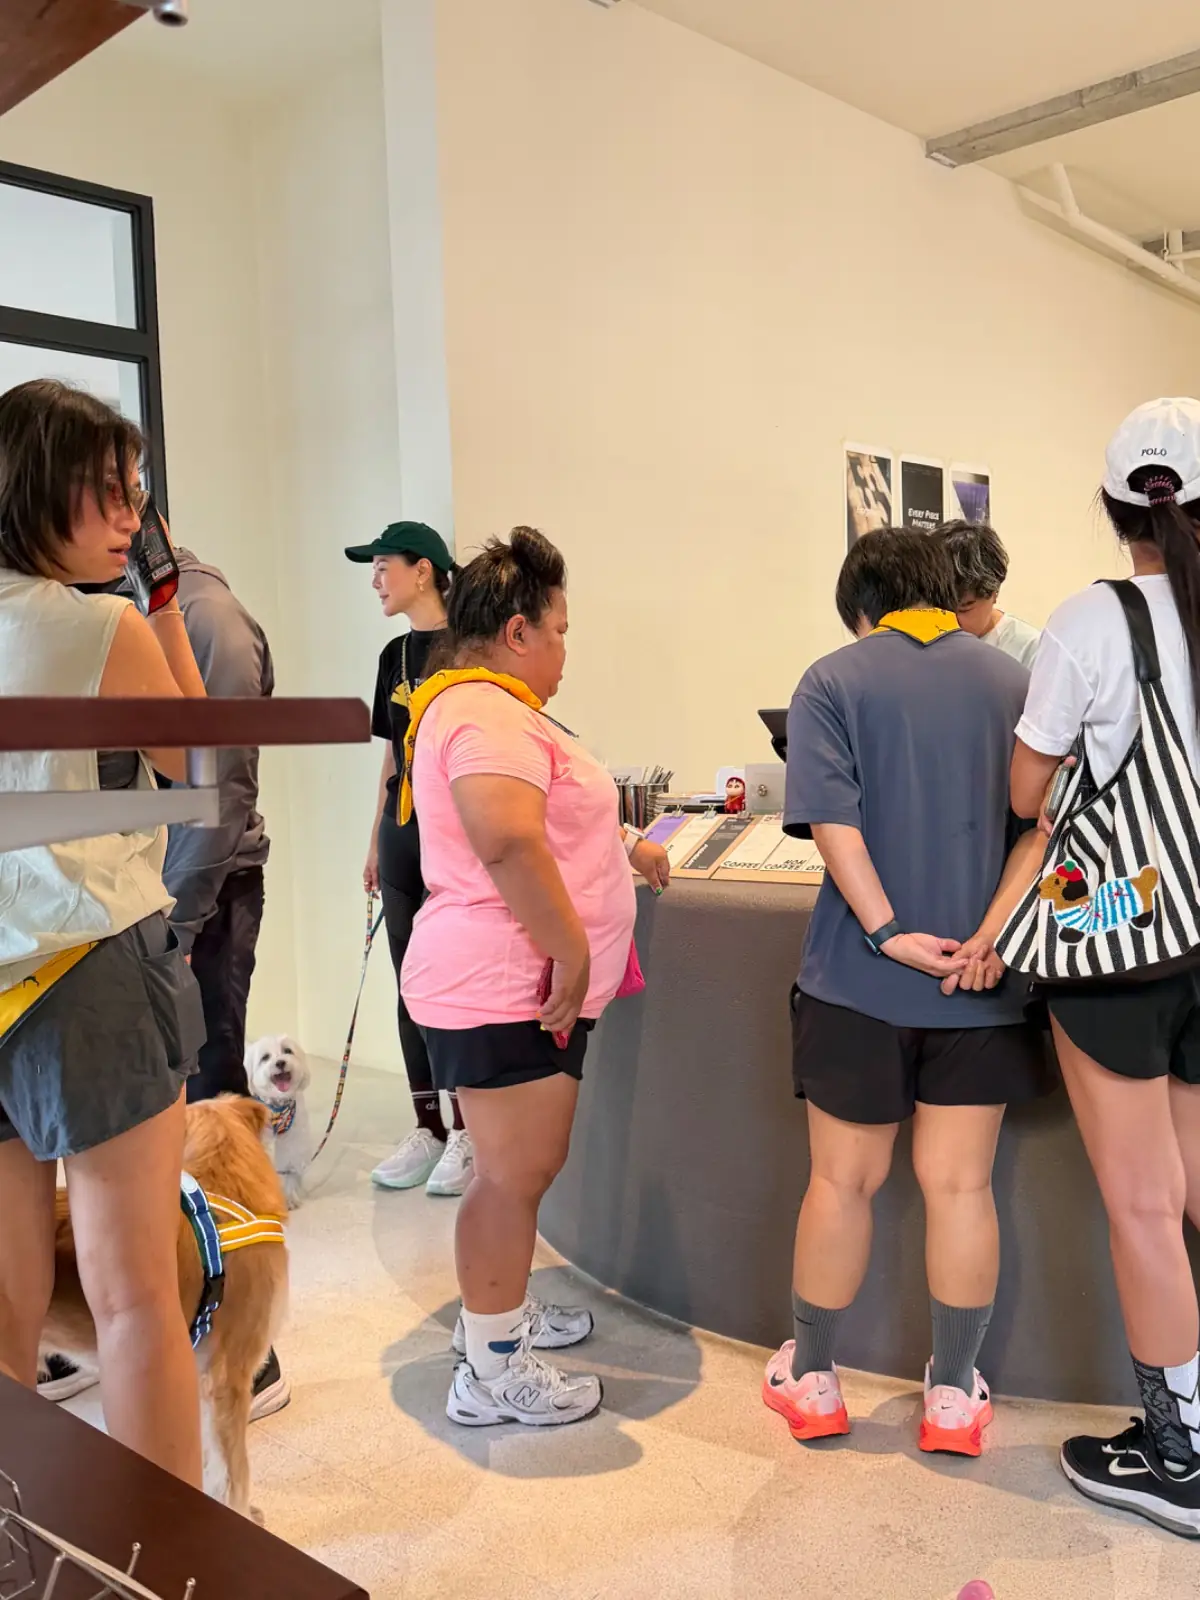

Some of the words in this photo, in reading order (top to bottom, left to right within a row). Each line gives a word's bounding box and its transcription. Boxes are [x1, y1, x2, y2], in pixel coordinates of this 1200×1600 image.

[1140, 447, 1168, 457] POLO
[723, 860, 761, 869] COFFEE
[763, 863, 802, 871] COFFEE
[513, 1385, 541, 1408] N
